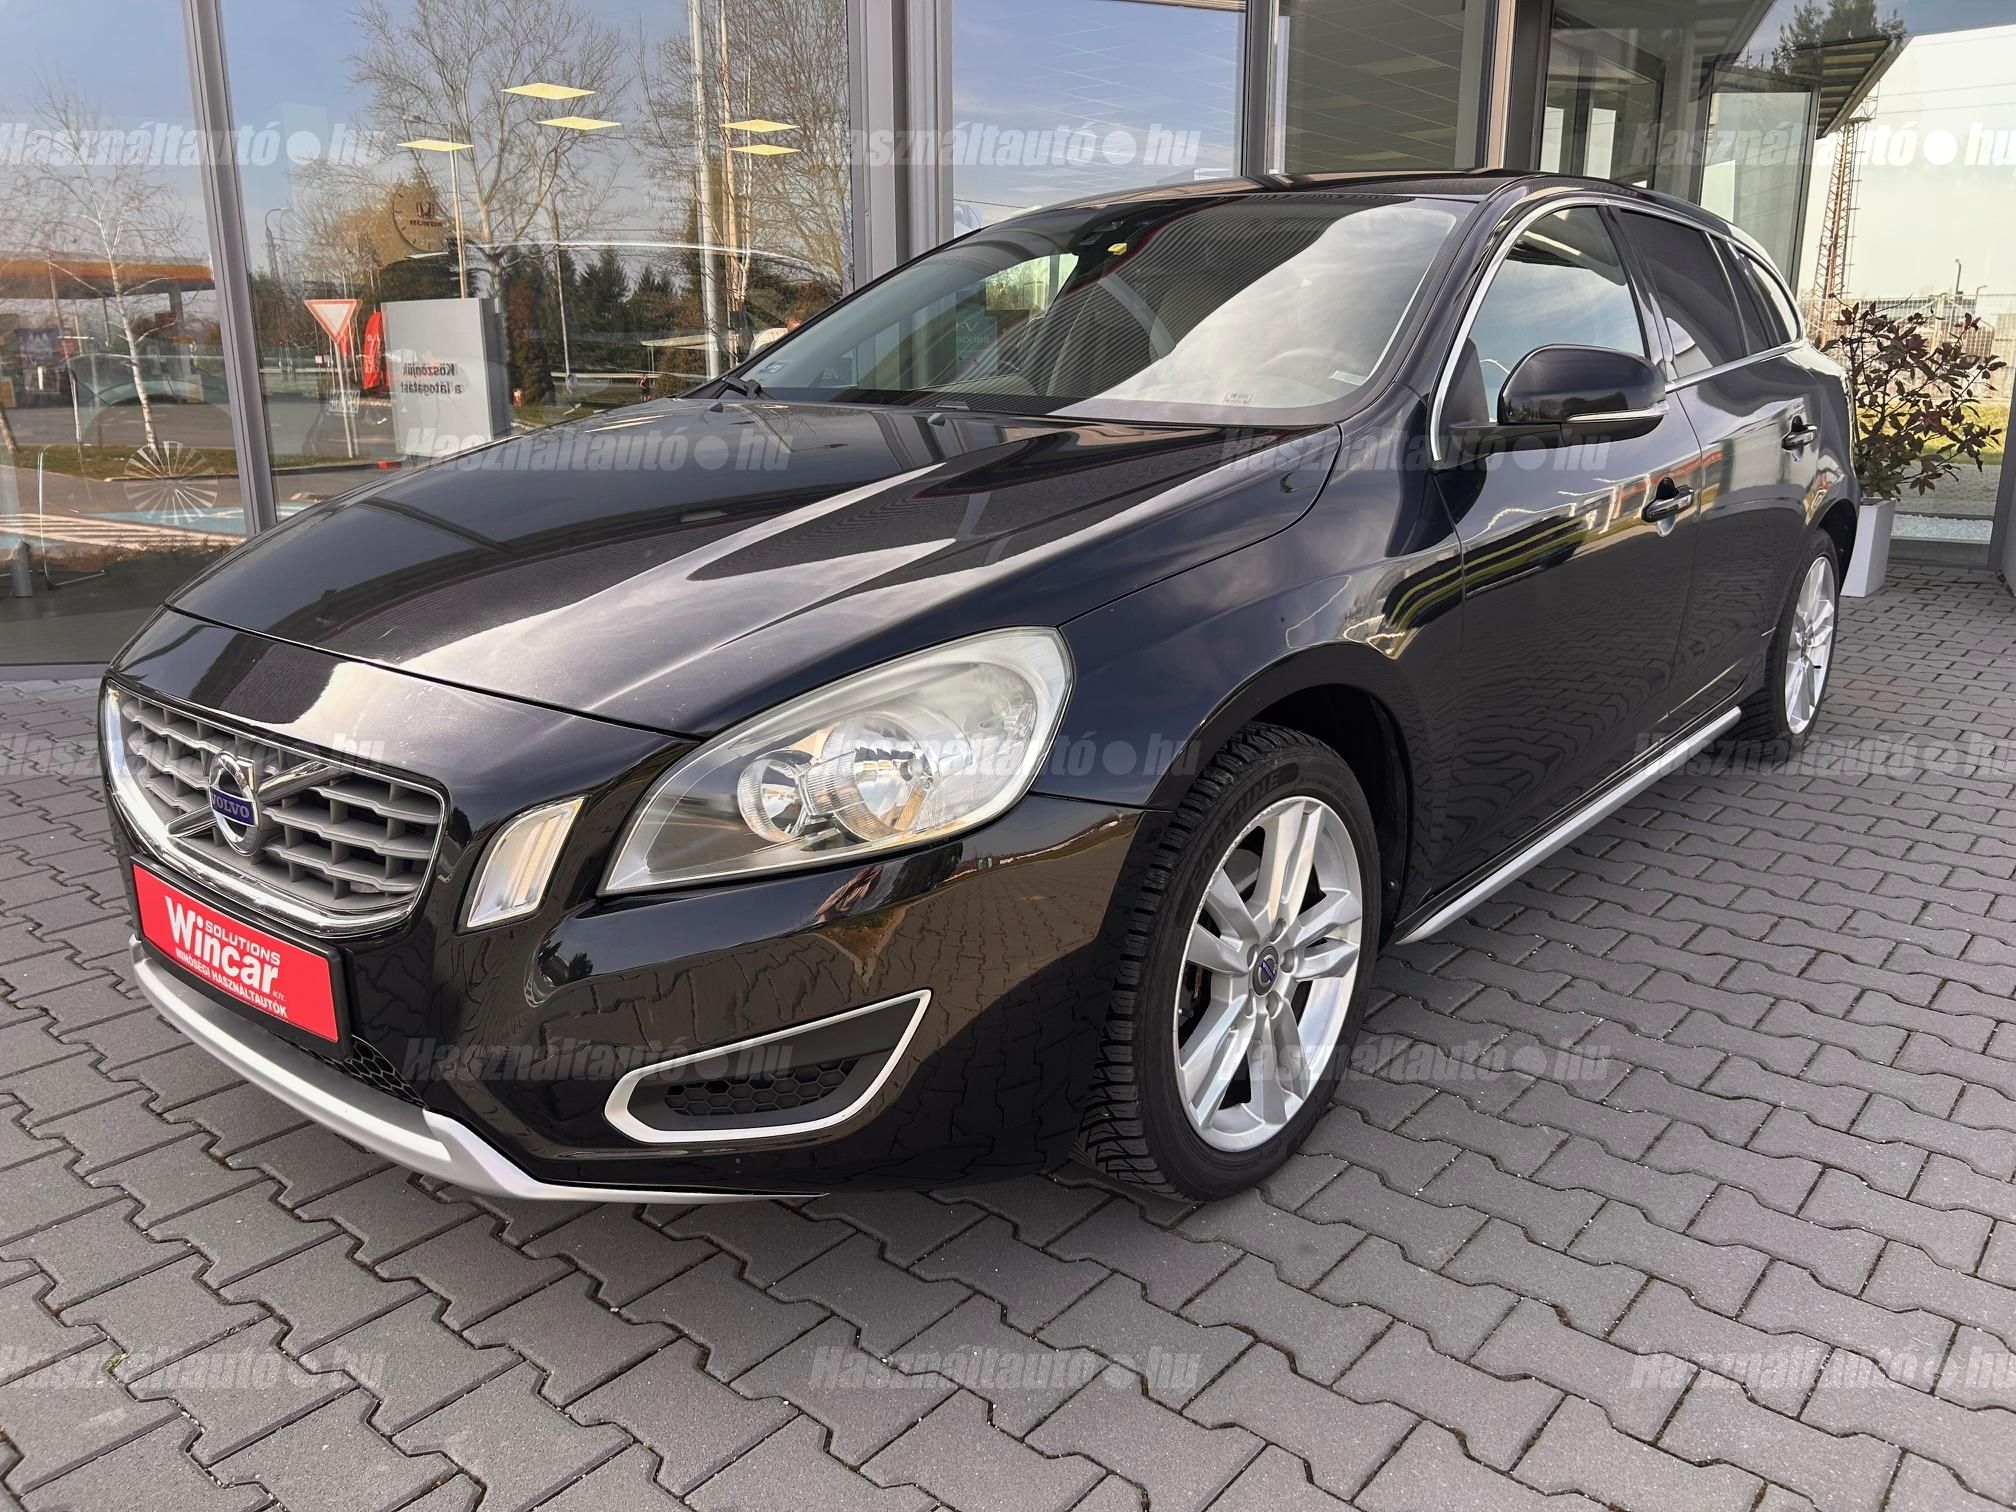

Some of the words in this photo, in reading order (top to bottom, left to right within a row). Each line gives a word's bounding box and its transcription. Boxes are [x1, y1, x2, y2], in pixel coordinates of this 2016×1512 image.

[211, 792, 250, 819] VOLVO
[165, 895, 279, 995] Wincar
[204, 919, 281, 966] SOLUTIONS
